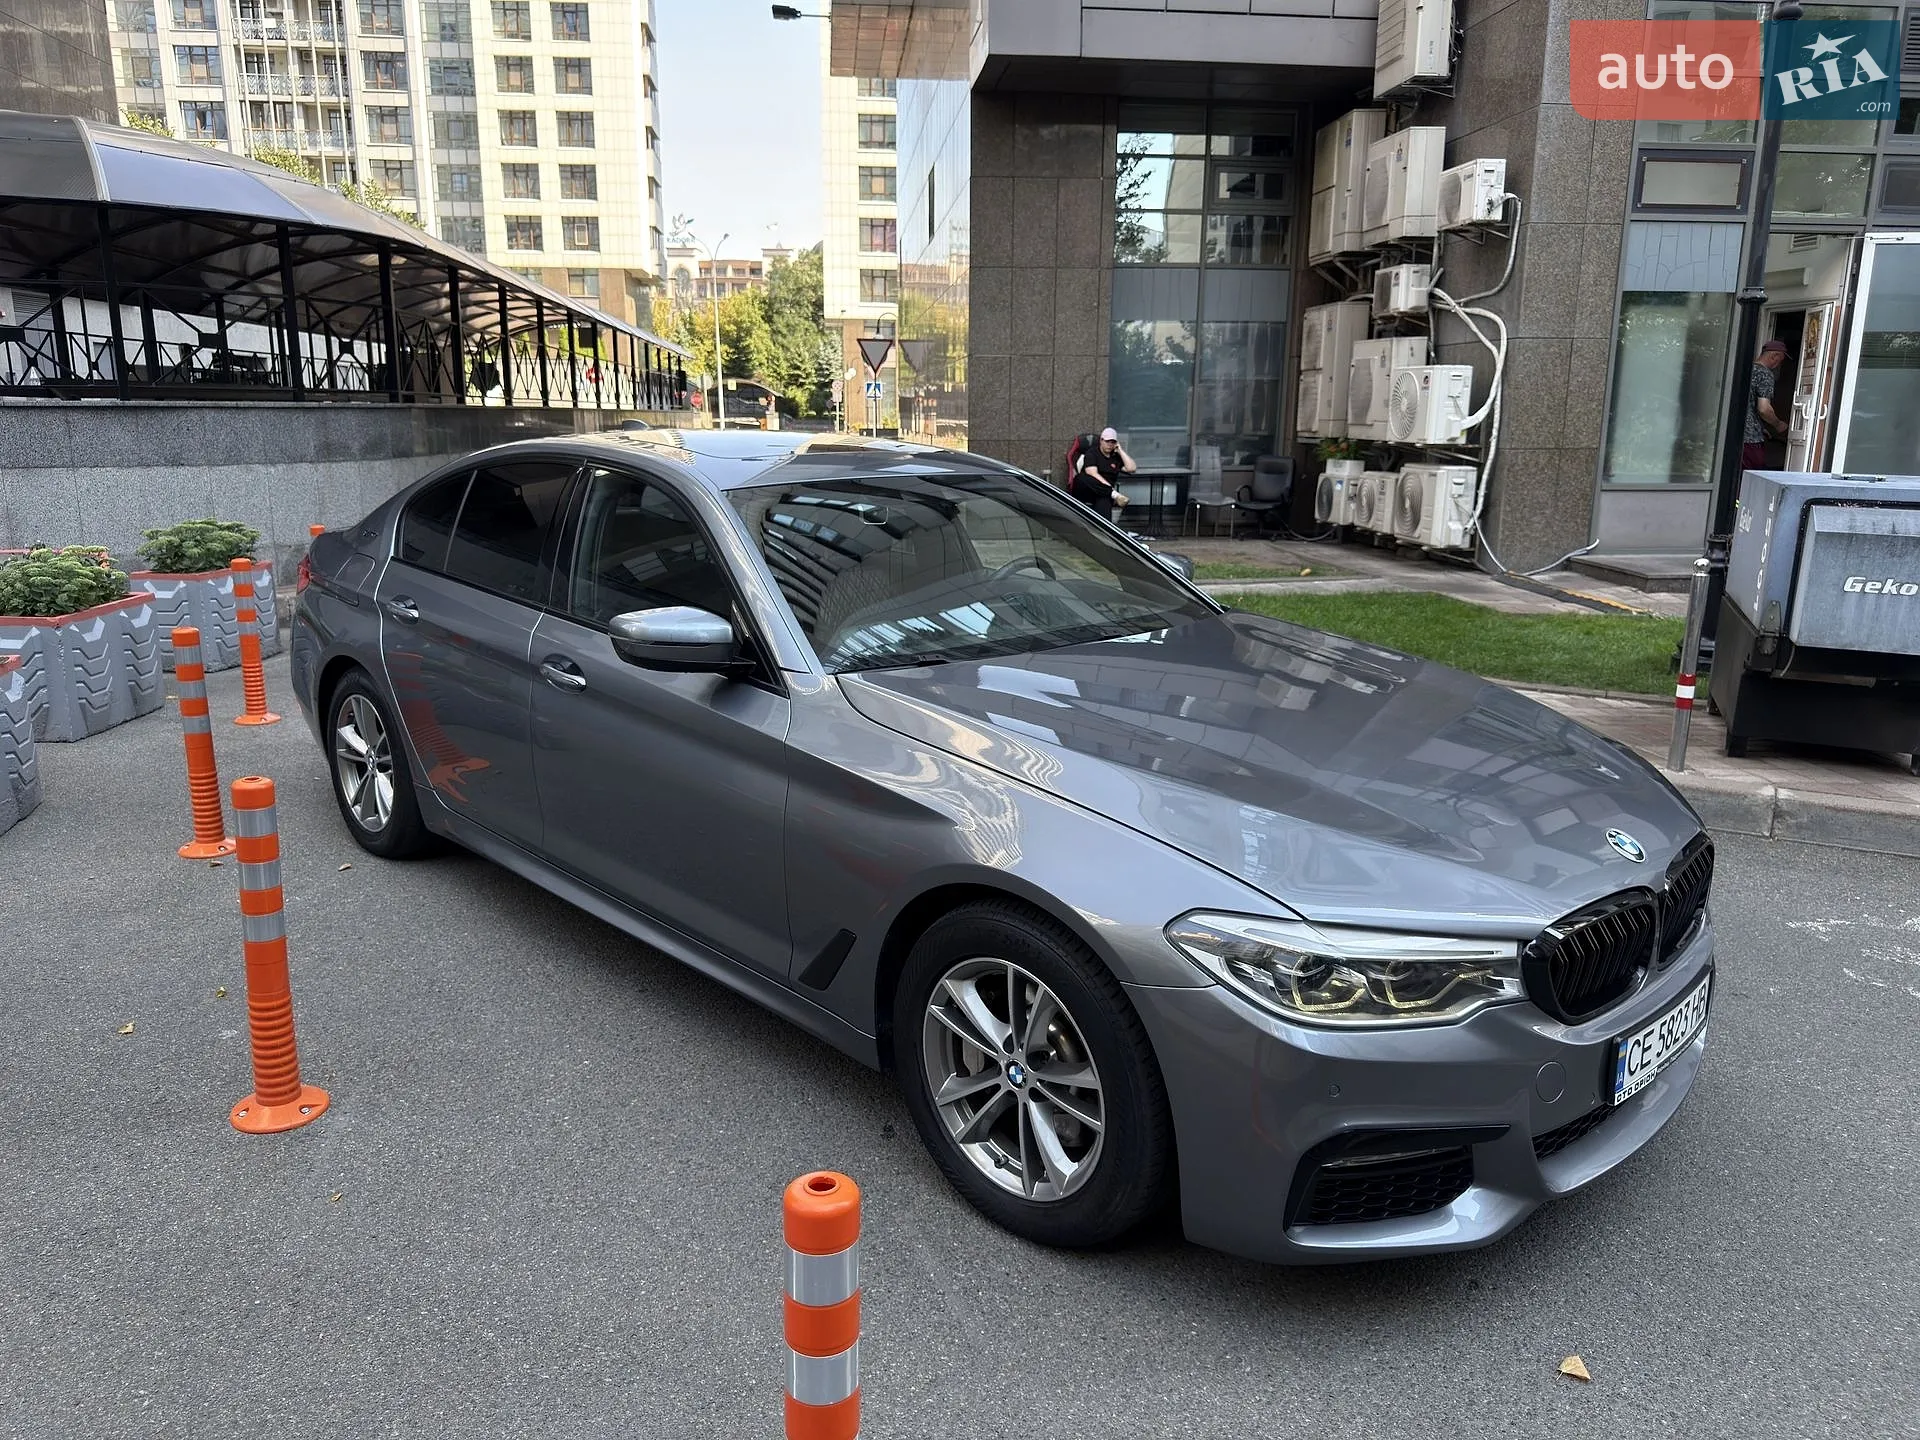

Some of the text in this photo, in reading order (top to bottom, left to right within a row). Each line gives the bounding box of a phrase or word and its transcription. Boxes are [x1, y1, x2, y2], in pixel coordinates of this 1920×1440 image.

[1843, 576, 1919, 596] Geko
[1628, 1028, 1655, 1076] CE
[1656, 1000, 1690, 1059] 5823
[1690, 982, 1707, 1030] HB
